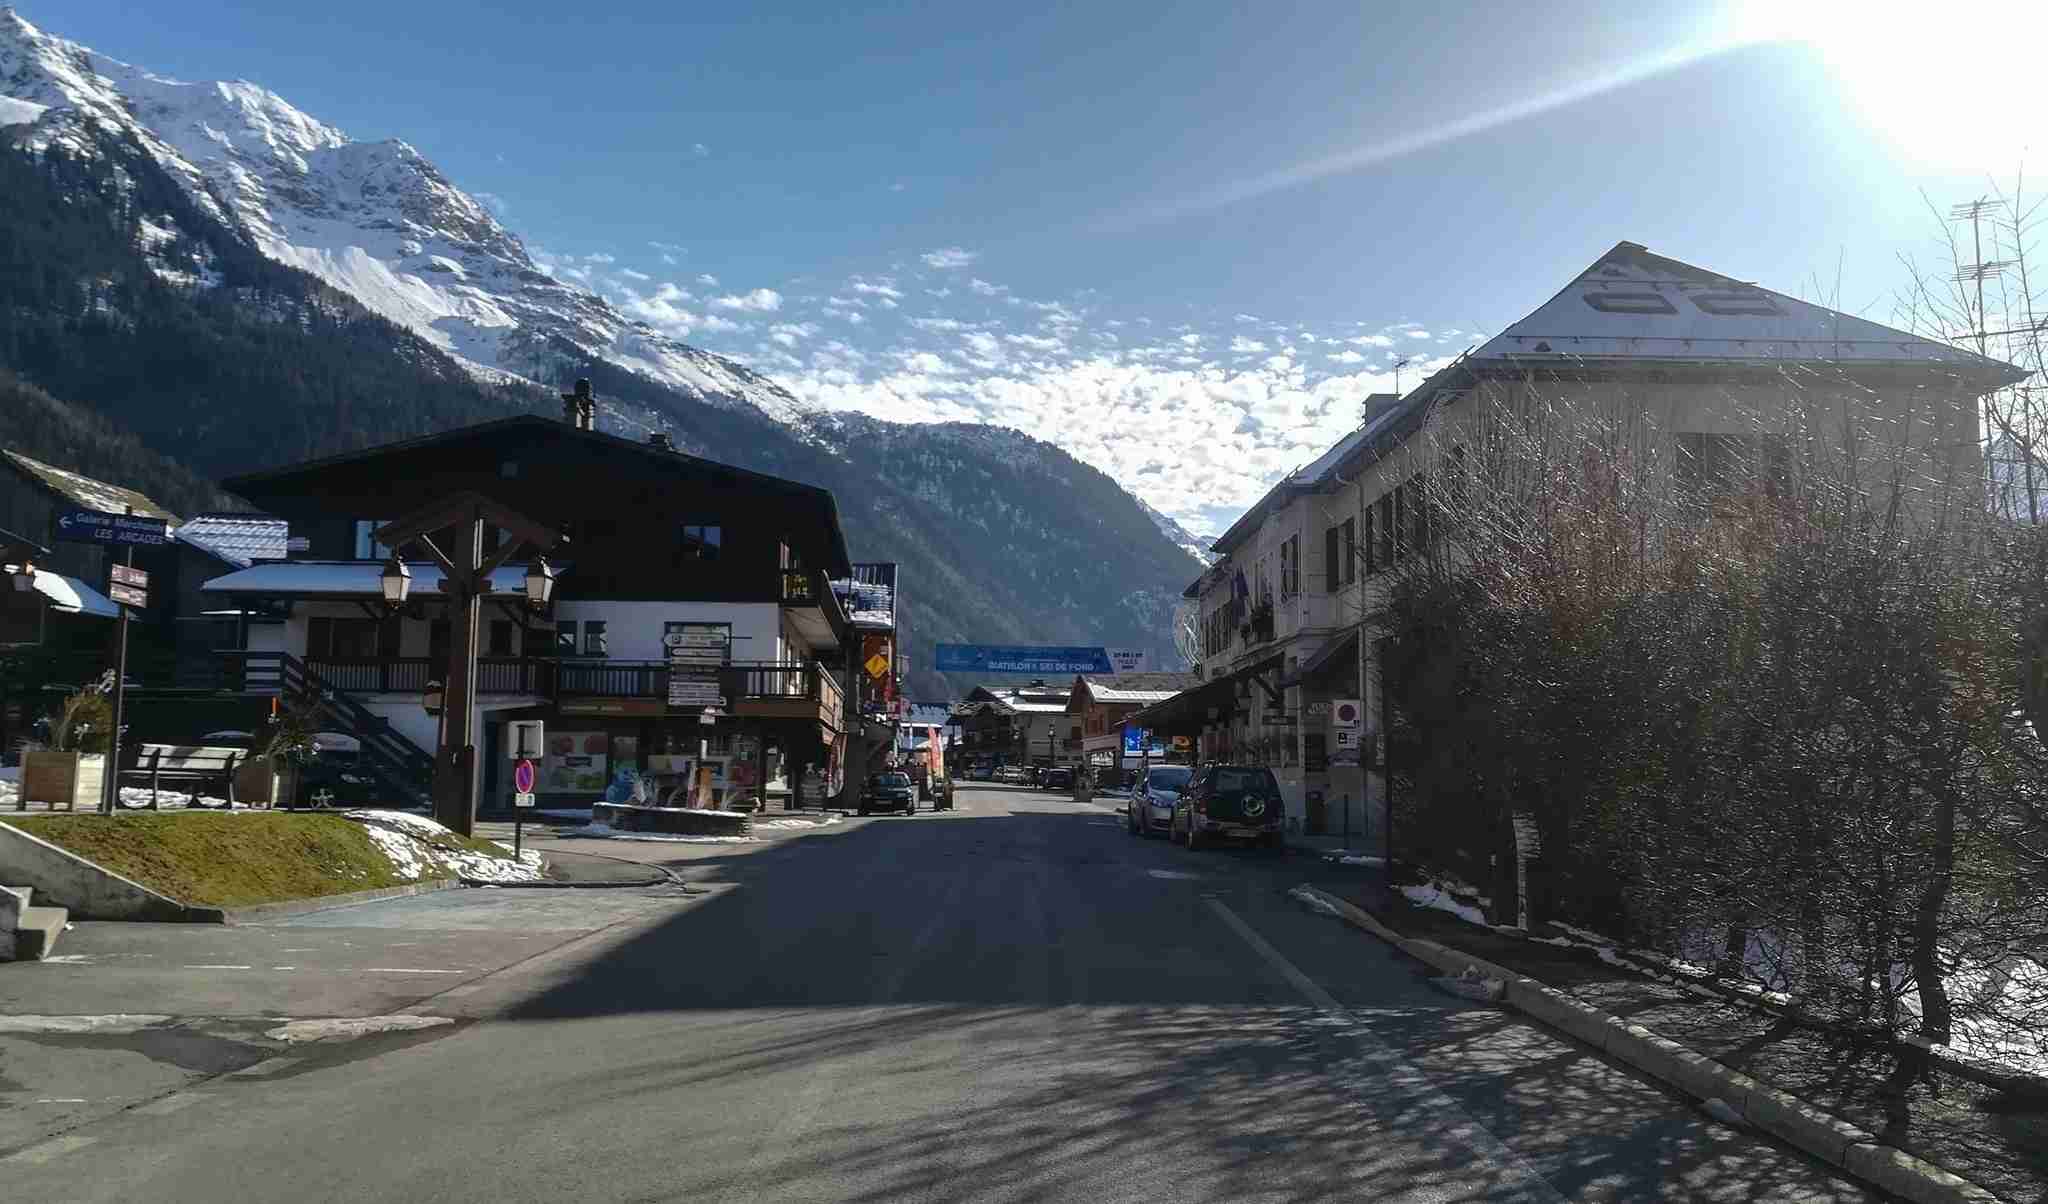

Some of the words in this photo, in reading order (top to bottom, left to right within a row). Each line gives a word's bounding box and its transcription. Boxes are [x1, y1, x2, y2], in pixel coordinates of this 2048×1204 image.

[95, 528, 112, 540] LES
[119, 531, 164, 544] ARCADES
[1069, 662, 1095, 672] FOND
